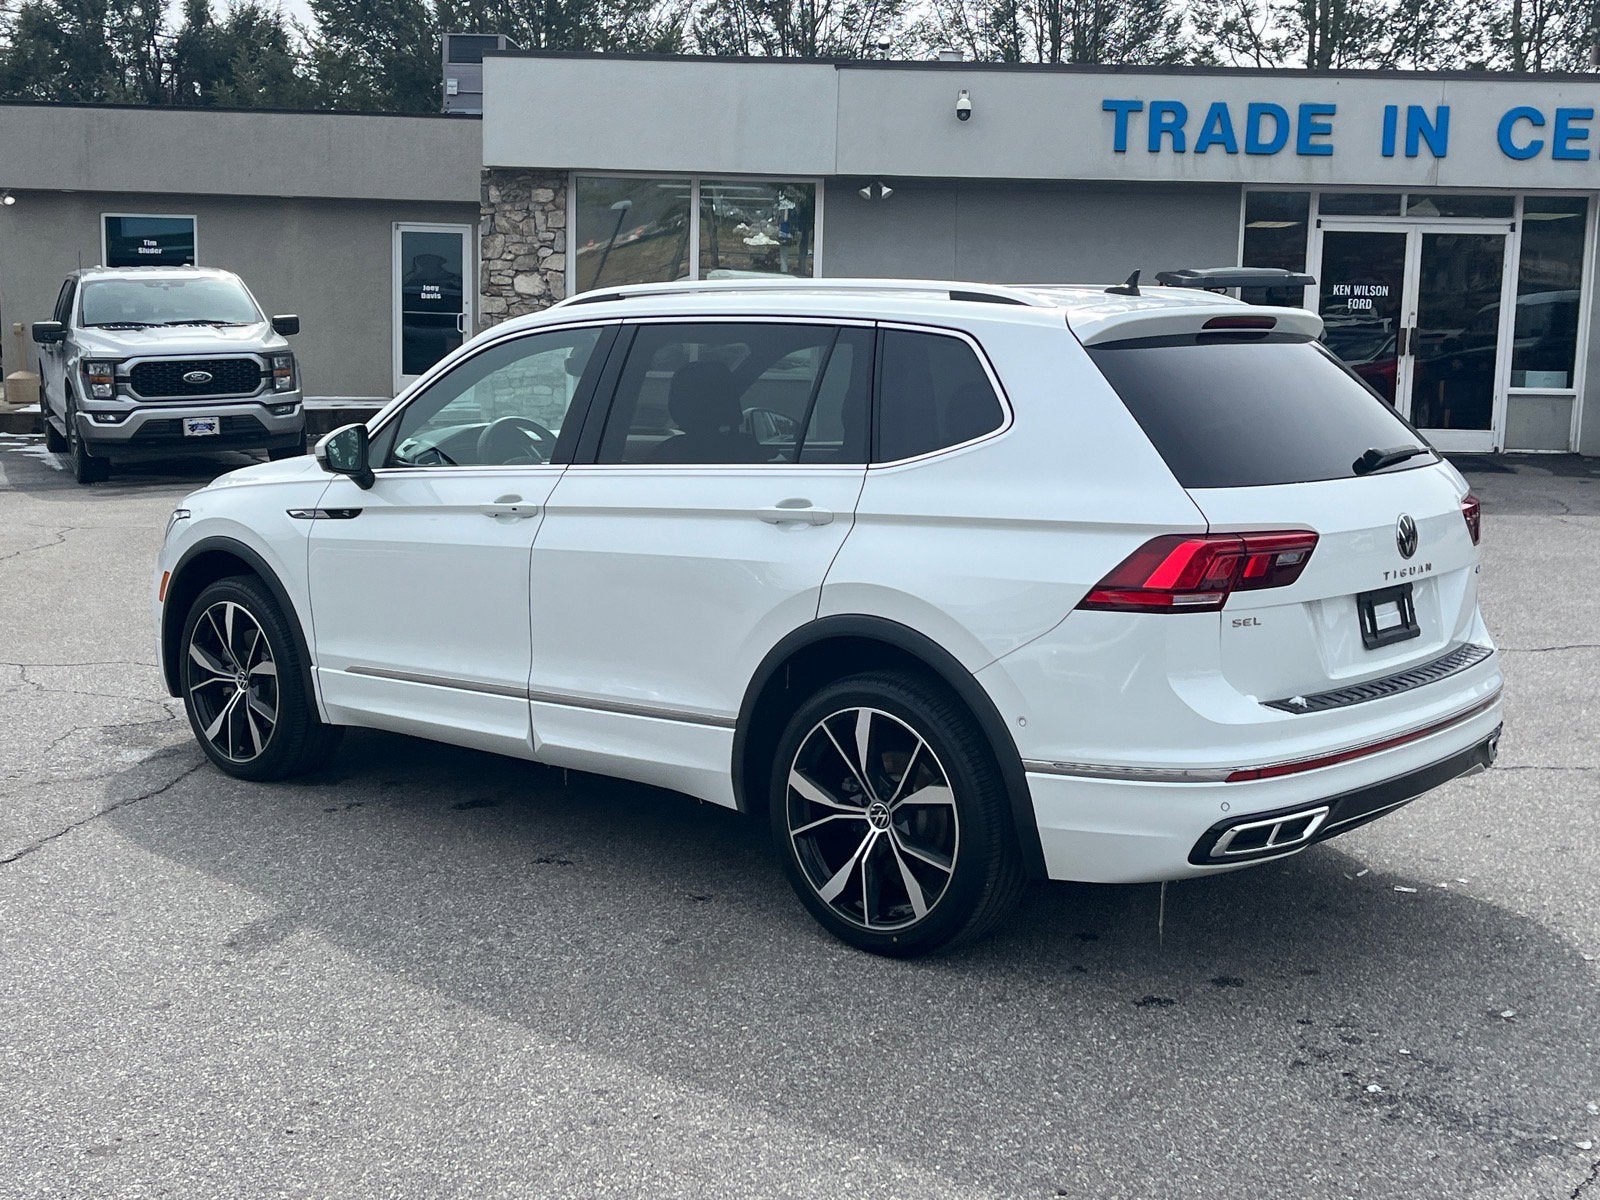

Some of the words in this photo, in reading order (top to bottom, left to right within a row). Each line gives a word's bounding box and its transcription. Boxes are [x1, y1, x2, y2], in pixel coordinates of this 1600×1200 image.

[1102, 99, 1336, 156] TRADE
[1382, 105, 1450, 158] IN
[1497, 106, 1600, 161] CE
[422, 284, 440, 292] Joey
[1333, 284, 1351, 296] KEN
[1353, 285, 1389, 297] WILSON
[1347, 298, 1373, 310] FORD
[1383, 562, 1433, 581] TIGUAN
[1231, 616, 1262, 628] SEL
